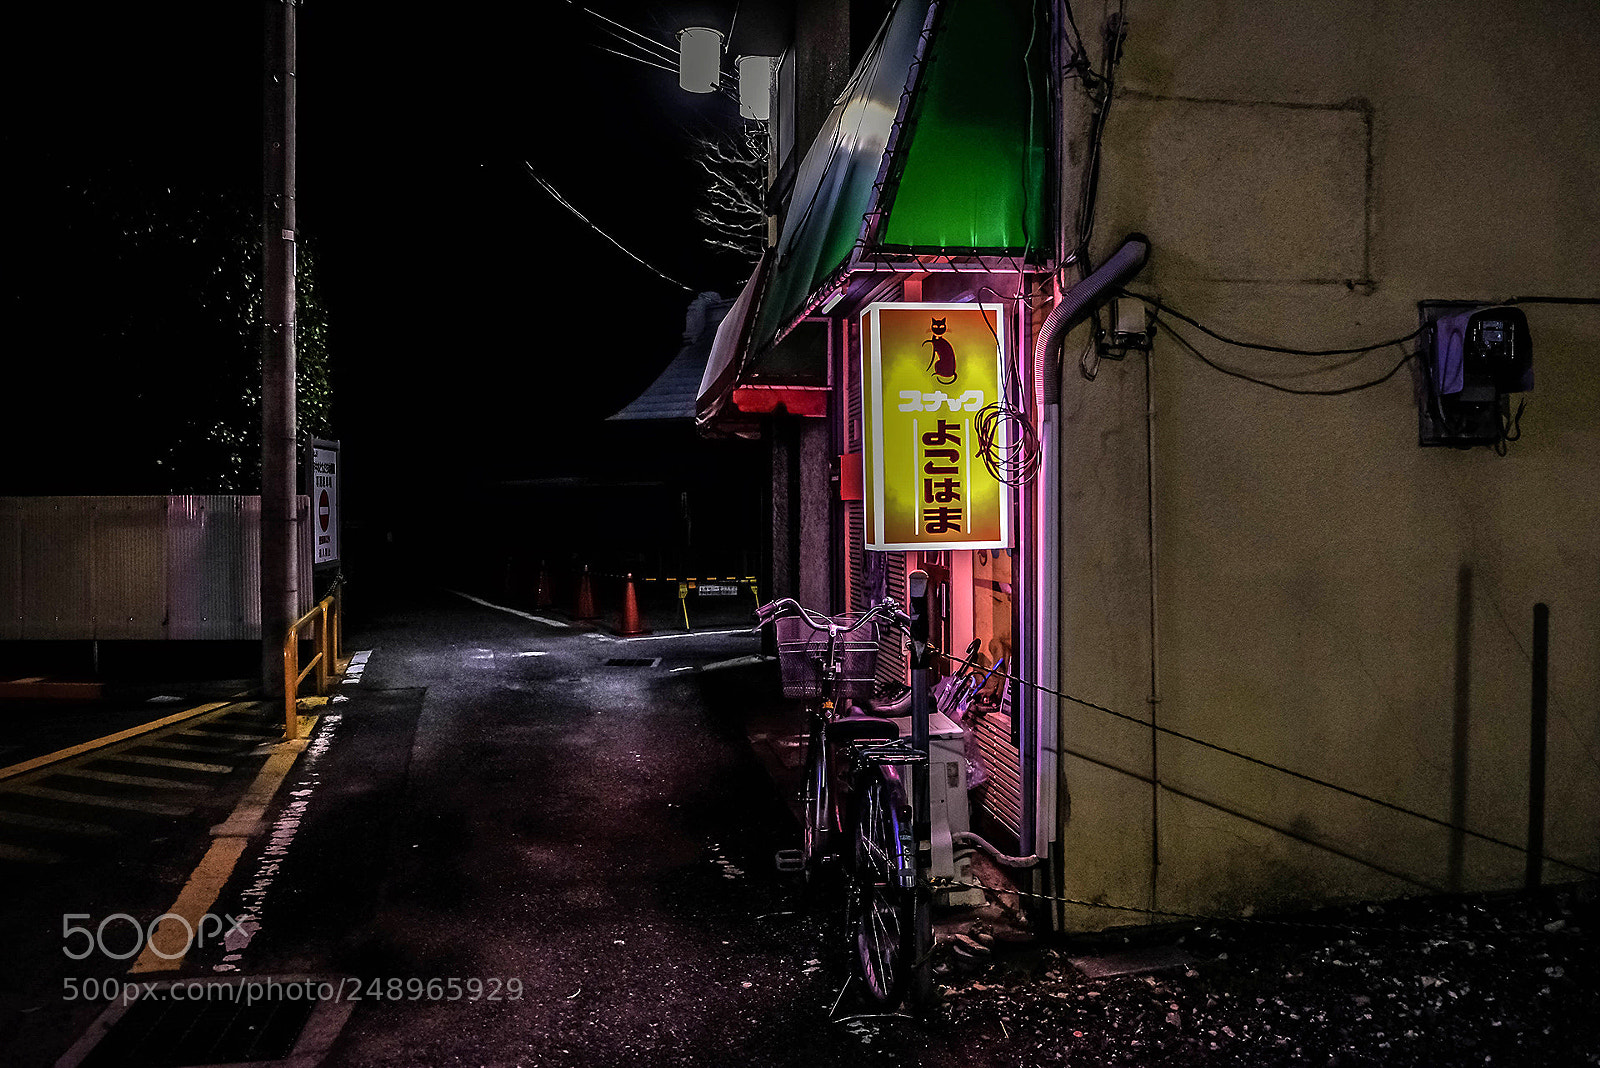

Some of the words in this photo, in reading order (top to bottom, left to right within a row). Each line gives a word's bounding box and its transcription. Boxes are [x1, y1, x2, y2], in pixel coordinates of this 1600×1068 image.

[898, 390, 984, 412] スナック
[922, 419, 963, 534] よこはま
